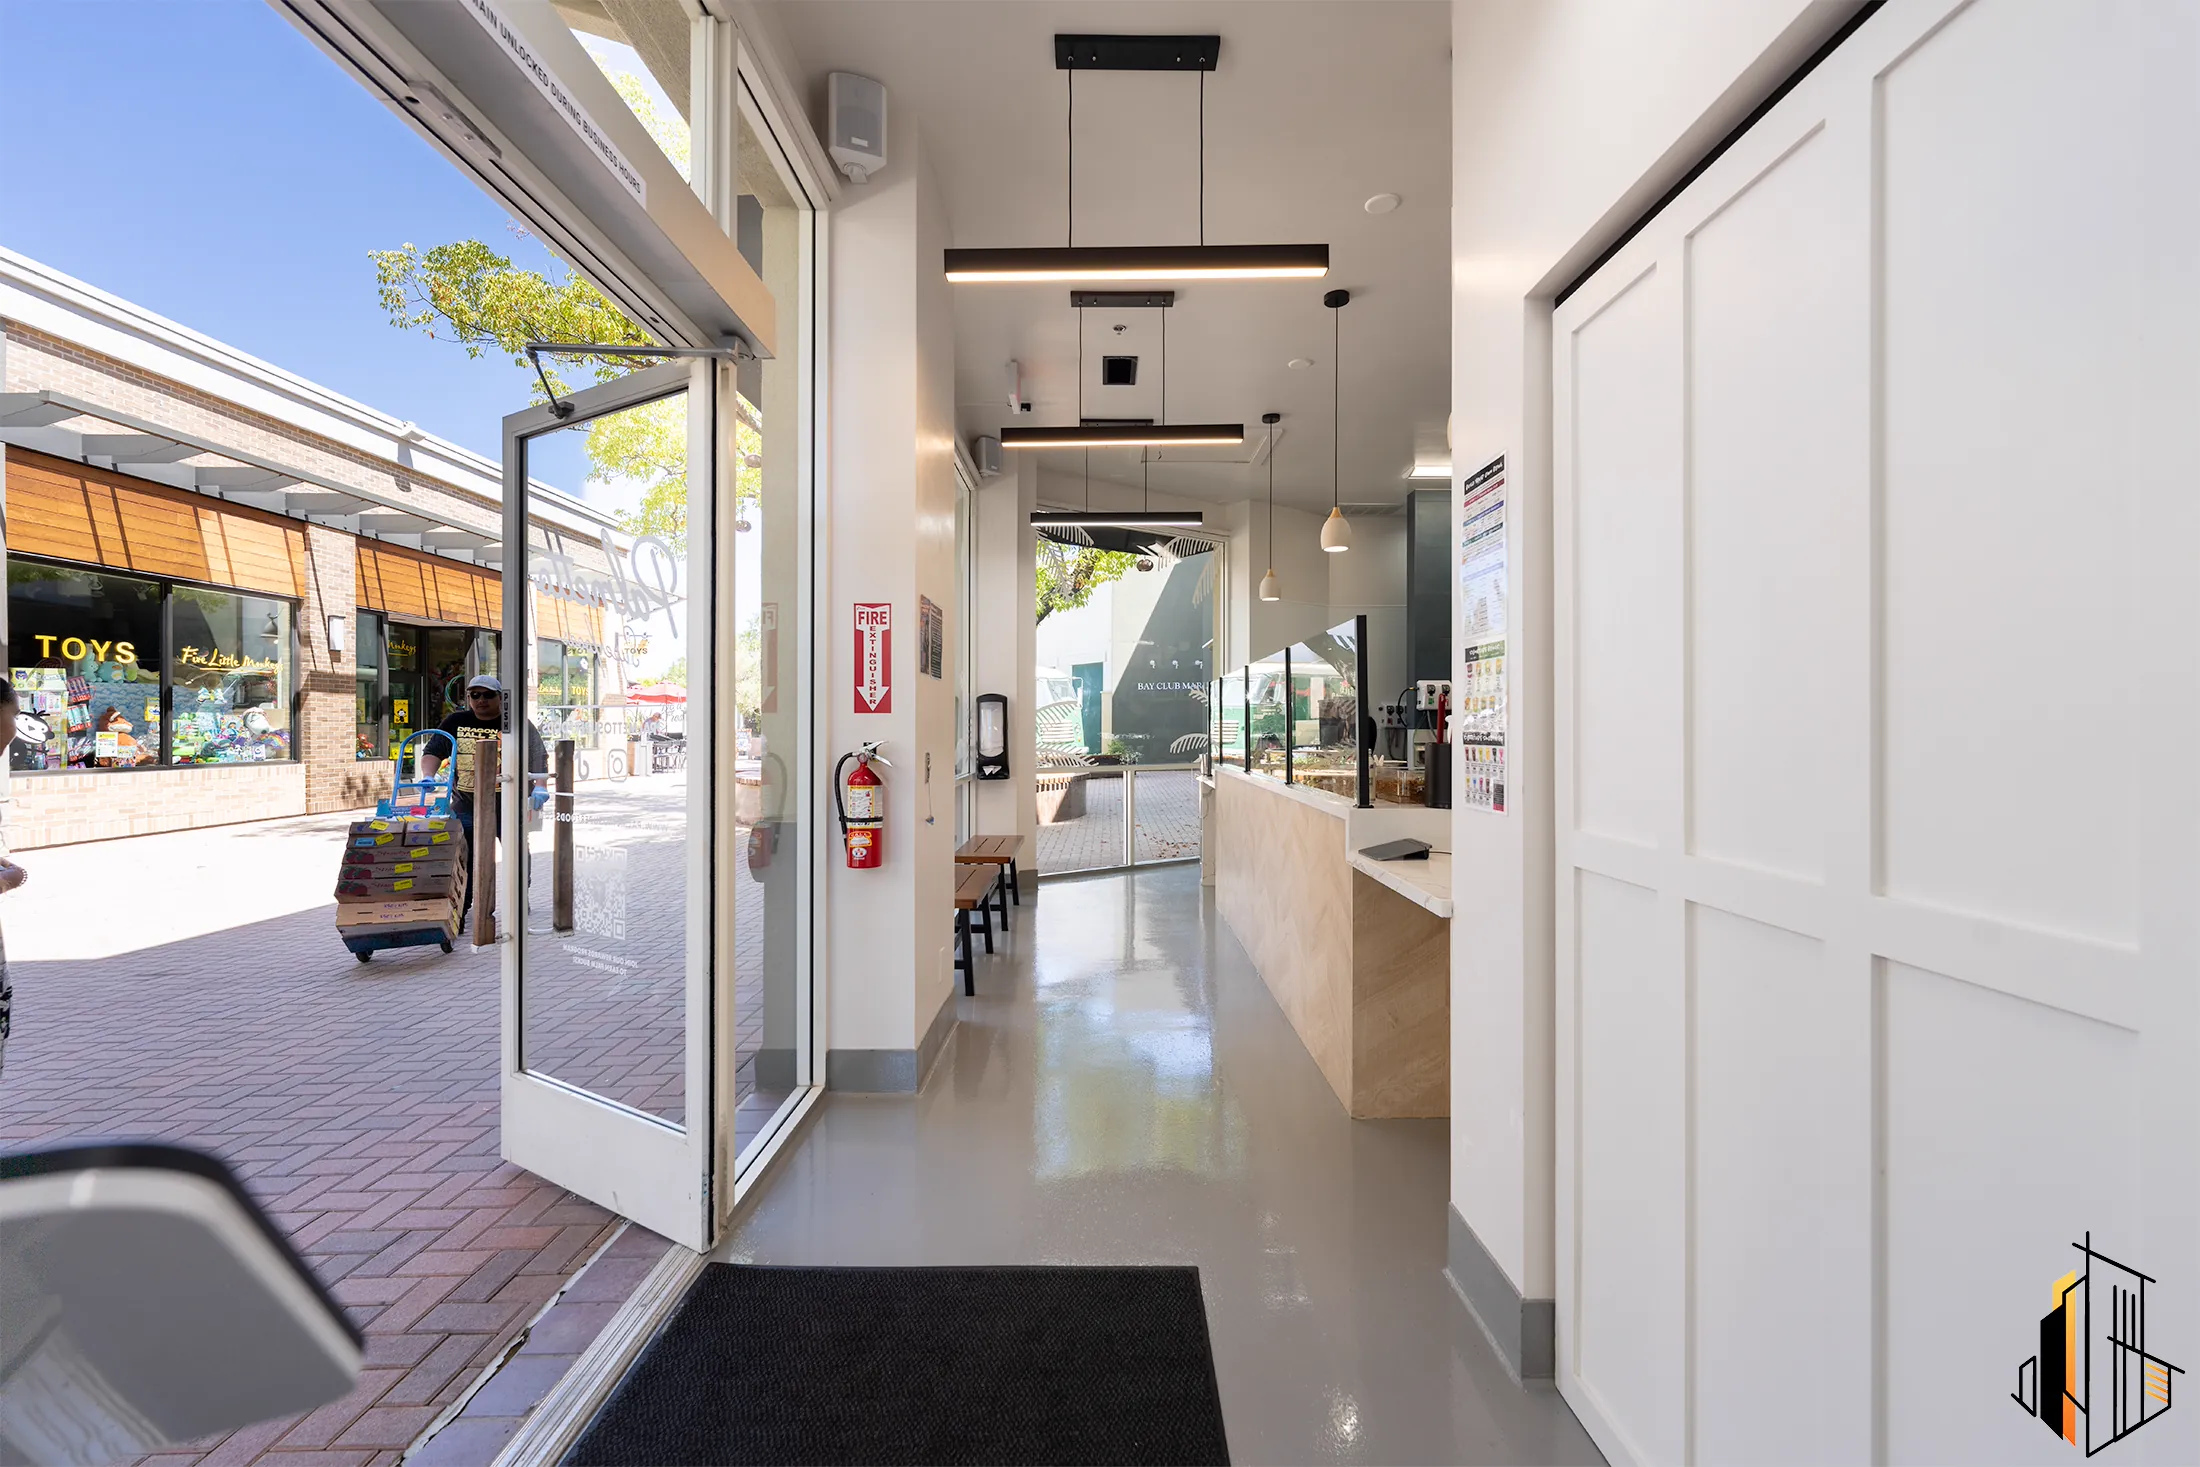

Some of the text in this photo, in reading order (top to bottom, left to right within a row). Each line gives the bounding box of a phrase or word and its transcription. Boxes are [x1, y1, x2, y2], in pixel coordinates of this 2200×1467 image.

[500, 21, 549, 87] UNLOCKED
[551, 82, 581, 125] DURING
[583, 119, 617, 167] BUSINESS
[619, 162, 641, 194] HOURS
[858, 611, 887, 625] FIRE
[34, 634, 137, 664] TOYS
[624, 647, 648, 655] TOYS
[182, 646, 284, 675] Five Little Monkeys
[869, 625, 877, 704] EXTINGUISHER
[1137, 682, 1155, 690] BAY
[1156, 682, 1181, 690] CLUB
[457, 726, 499, 734] DRAGON
